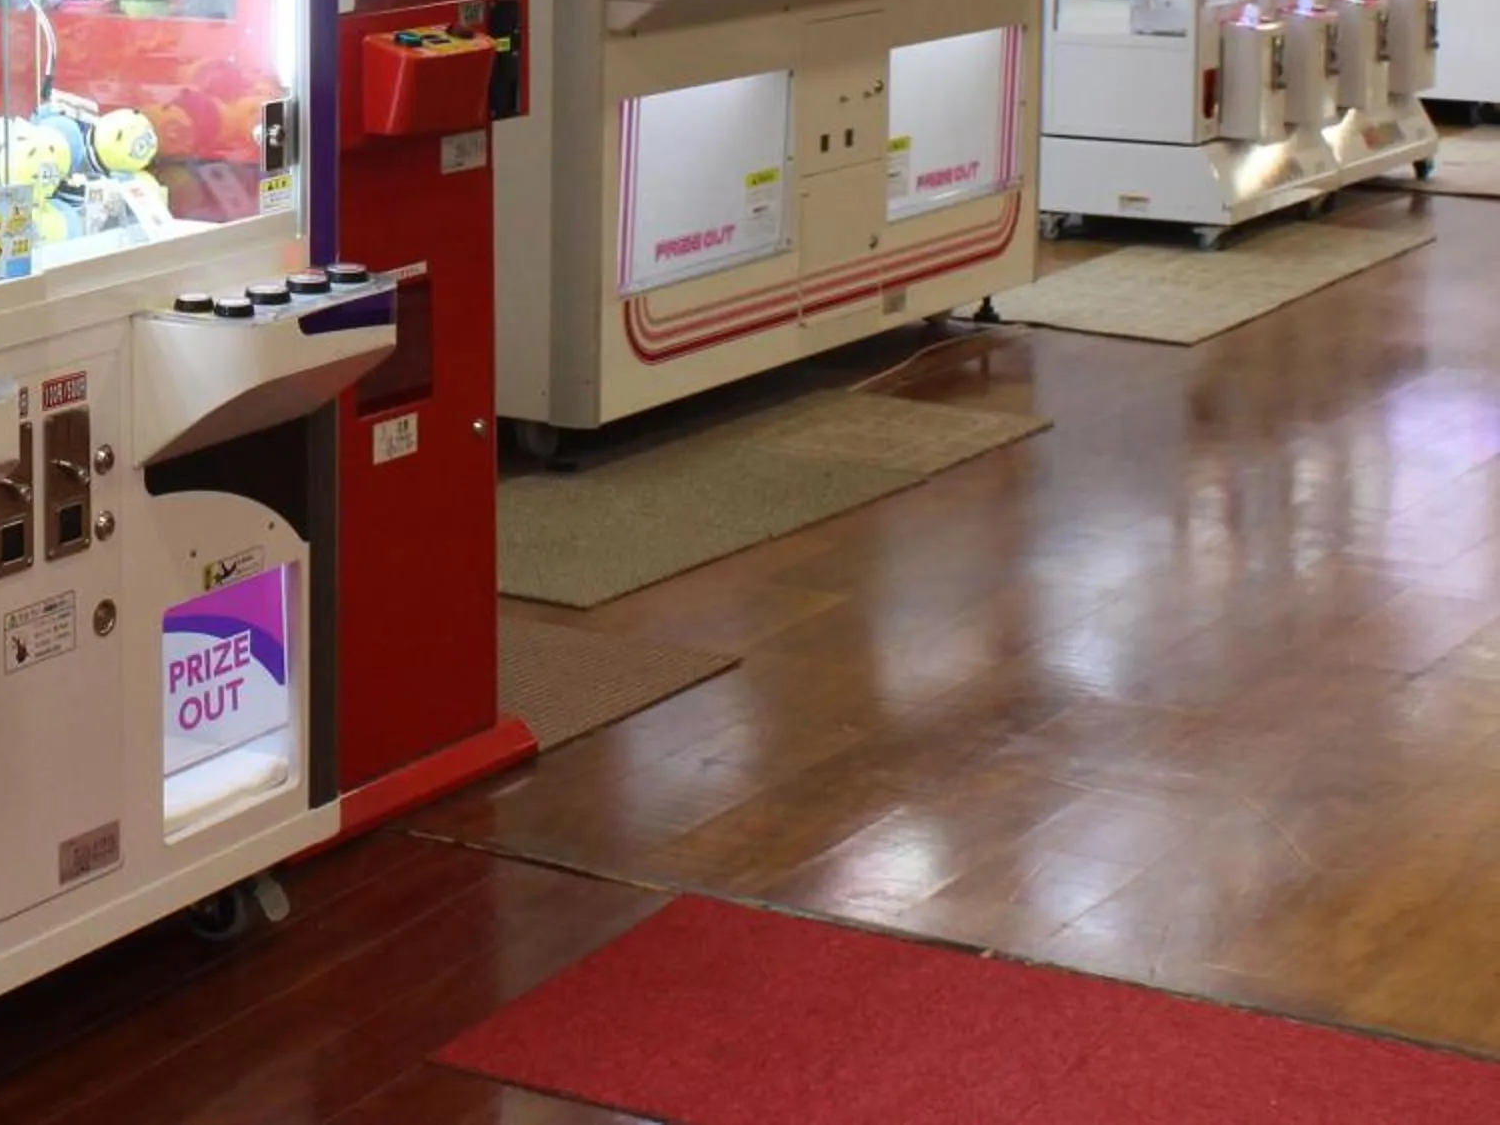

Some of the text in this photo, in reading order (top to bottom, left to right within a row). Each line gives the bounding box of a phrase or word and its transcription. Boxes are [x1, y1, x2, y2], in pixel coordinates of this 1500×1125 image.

[703, 223, 736, 248] OUT
[169, 634, 250, 694] PRIZE
[179, 677, 244, 731] OUT
